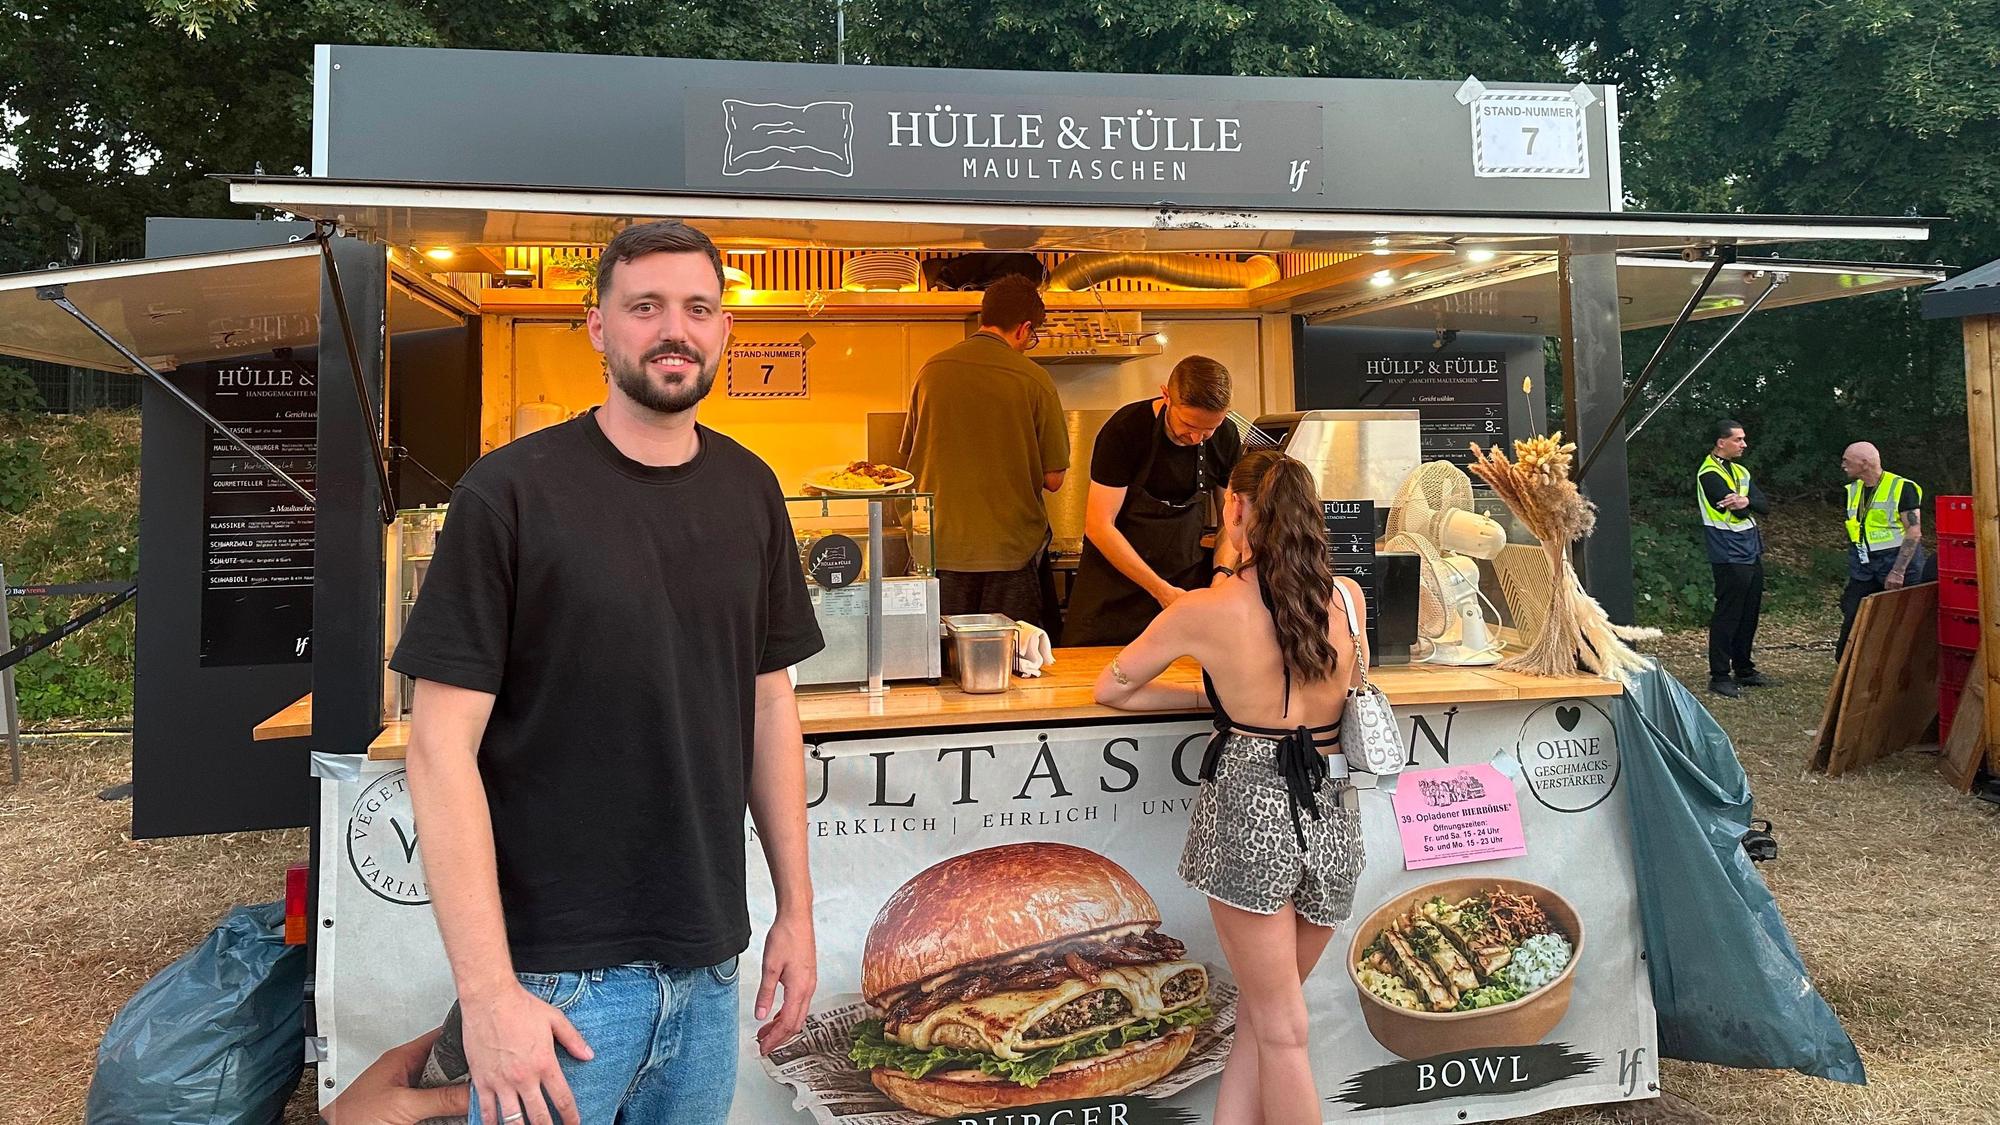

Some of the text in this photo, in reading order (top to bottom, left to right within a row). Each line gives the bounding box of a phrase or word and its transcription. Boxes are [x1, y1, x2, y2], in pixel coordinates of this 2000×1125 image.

[1483, 106, 1574, 118] STAND-NUMMER
[888, 104, 1242, 153] HÜLLE & FÜLLE
[1521, 127, 1540, 155] 7
[962, 157, 1188, 181] MAULTASCHEN
[733, 350, 801, 358] STAND-NUMMER
[1366, 357, 1498, 375] HÜLLE & FÜLLE
[217, 365, 315, 386] HÜLLE &
[760, 364, 775, 385] 7
[246, 390, 310, 398] HANDGEMACHTE
[213, 480, 263, 488] GOURMETTELLER
[1324, 502, 1361, 514] FÜLLE
[209, 540, 254, 548] SCHWARZWALD
[209, 576, 248, 584] SCHWABIOLI
[13, 588, 46, 596] BayArena
[1536, 737, 1600, 760] OHNE
[1534, 760, 1612, 778] GESCHMACKS-
[1535, 774, 1606, 791] VERSTÄRKER
[983, 805, 1098, 828] EHRLICH
[1401, 815, 1415, 824] 39.
[1416, 810, 1460, 823] Opladener
[1433, 820, 1488, 833] Öffnungszeiten:
[1435, 833, 1449, 842] und
[1450, 831, 1461, 840] Sa.
[1463, 830, 1472, 838] 15
[1477, 828, 1486, 836] 24
[1487, 827, 1499, 836] Uhr
[1424, 844, 1436, 852] So.
[1437, 842, 1451, 851] und
[1452, 840, 1464, 849] Mo.
[1467, 839, 1475, 847] 15
[1480, 837, 1489, 845] 23
[1490, 836, 1503, 844] Uhr
[1416, 1055, 1529, 1093] BOWL
